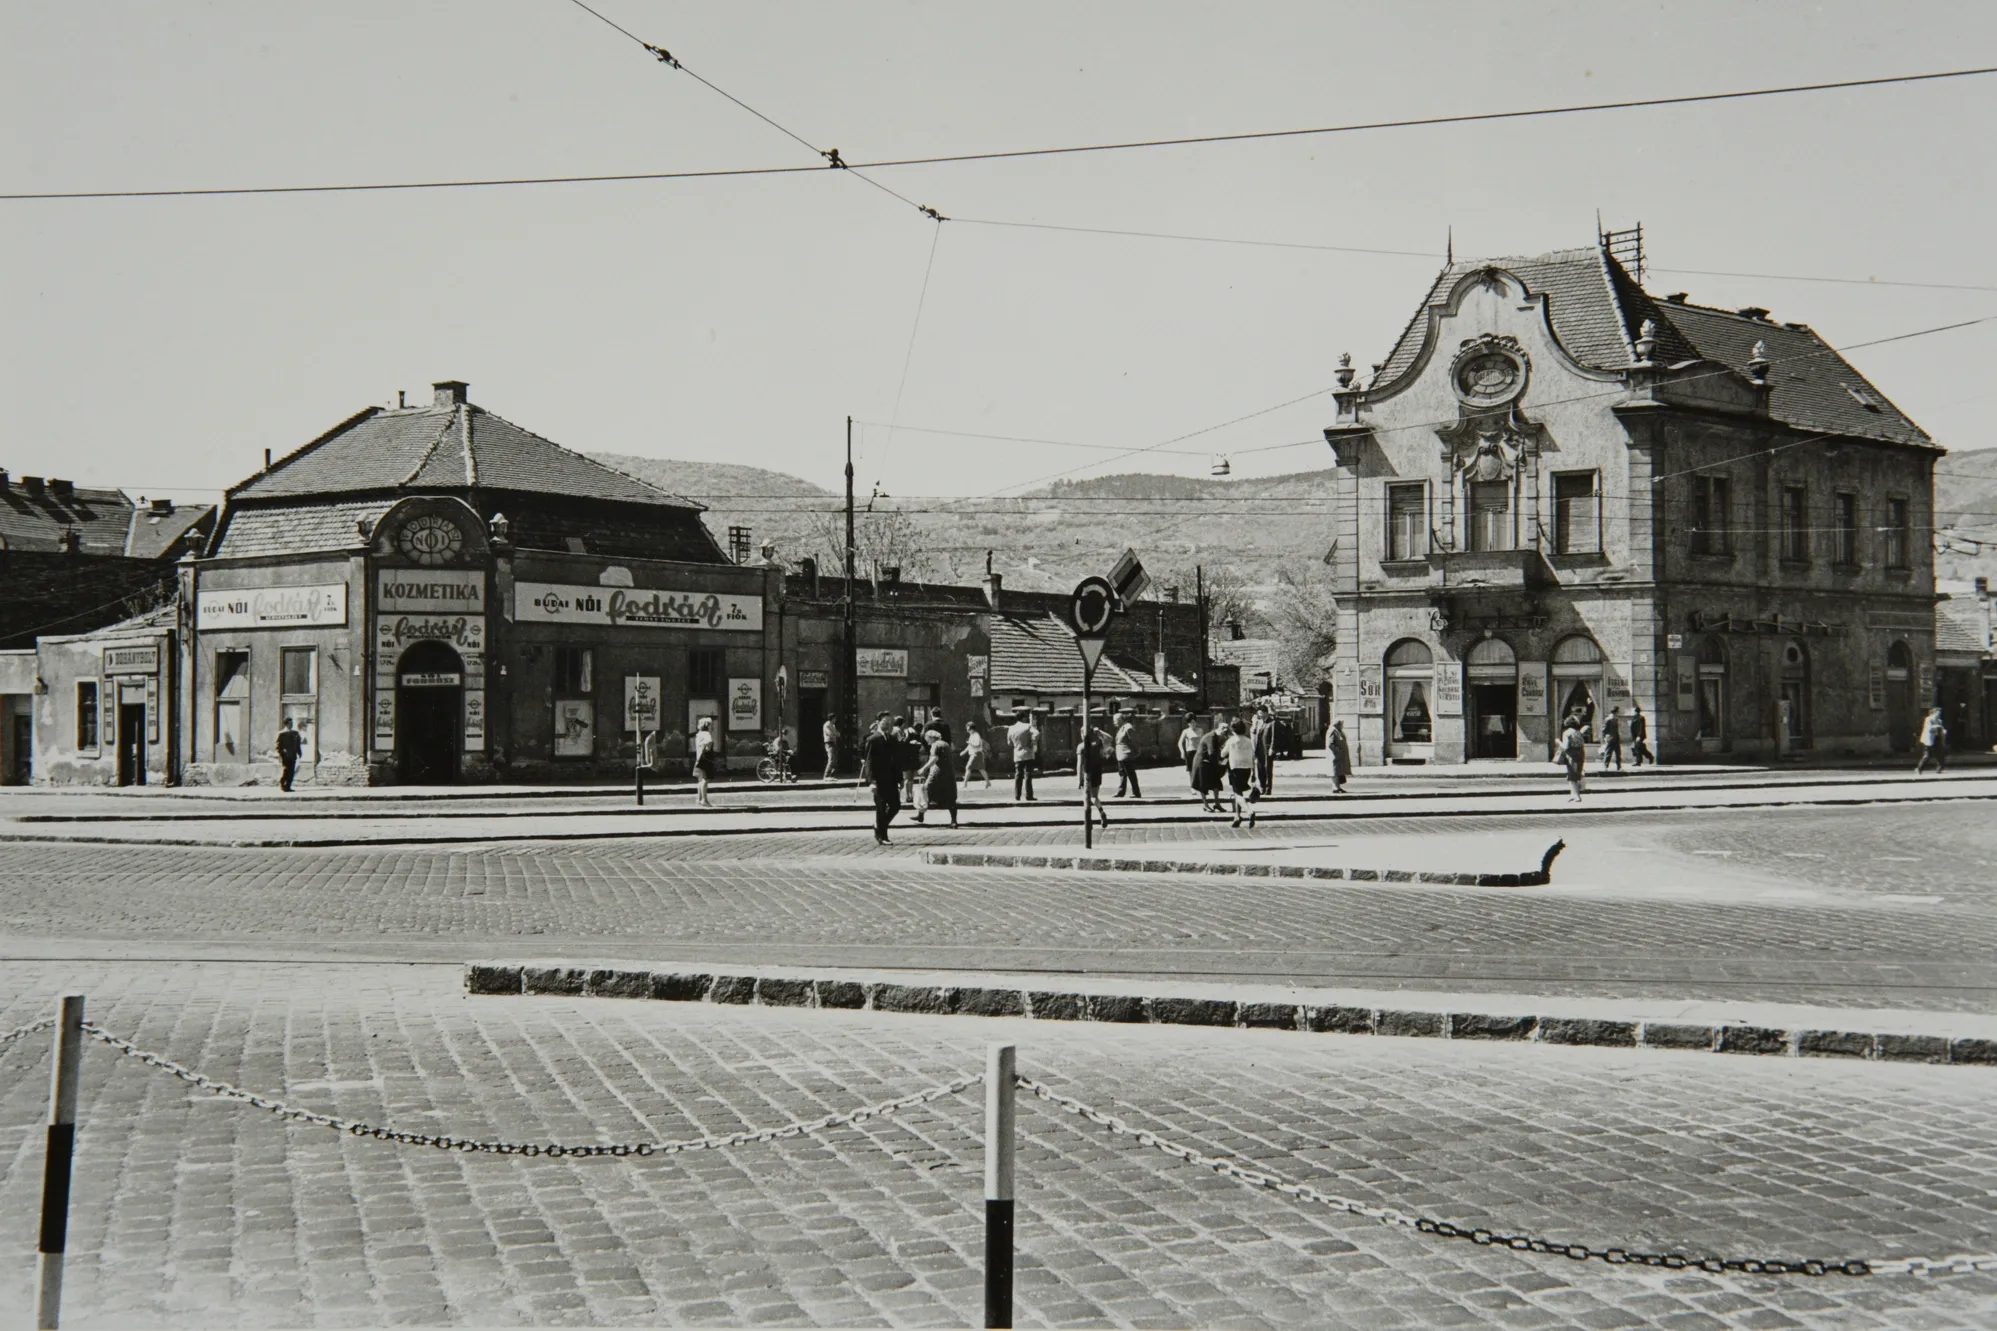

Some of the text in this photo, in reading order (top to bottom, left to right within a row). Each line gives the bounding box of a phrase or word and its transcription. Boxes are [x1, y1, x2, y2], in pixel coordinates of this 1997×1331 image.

[252, 589, 323, 626] fodrász
[383, 583, 480, 601] KOZMETIKA
[534, 598, 569, 609] BUDAI
[575, 595, 601, 613] NŐI
[606, 590, 723, 628] fodrász
[392, 616, 468, 647] fodrász
